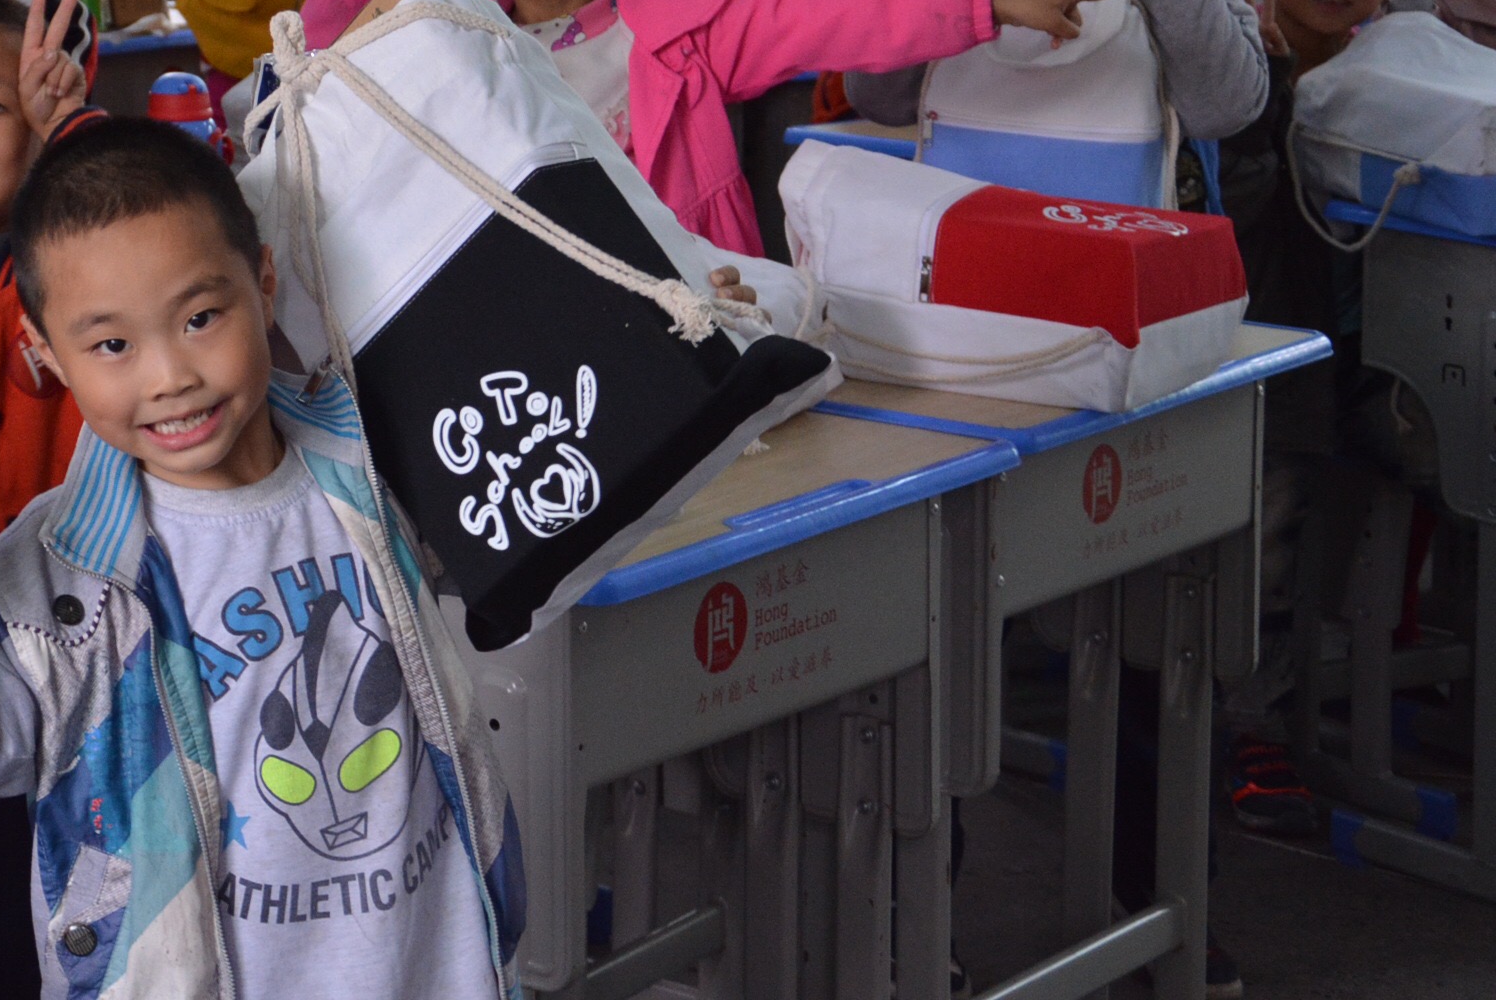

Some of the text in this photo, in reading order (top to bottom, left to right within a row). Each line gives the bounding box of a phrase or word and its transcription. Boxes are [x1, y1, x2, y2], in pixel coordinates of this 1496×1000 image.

[191, 552, 386, 702] ASHI
[754, 602, 789, 627] Hong
[754, 608, 838, 651] Foundation
[216, 868, 396, 925] ATHLETIC
